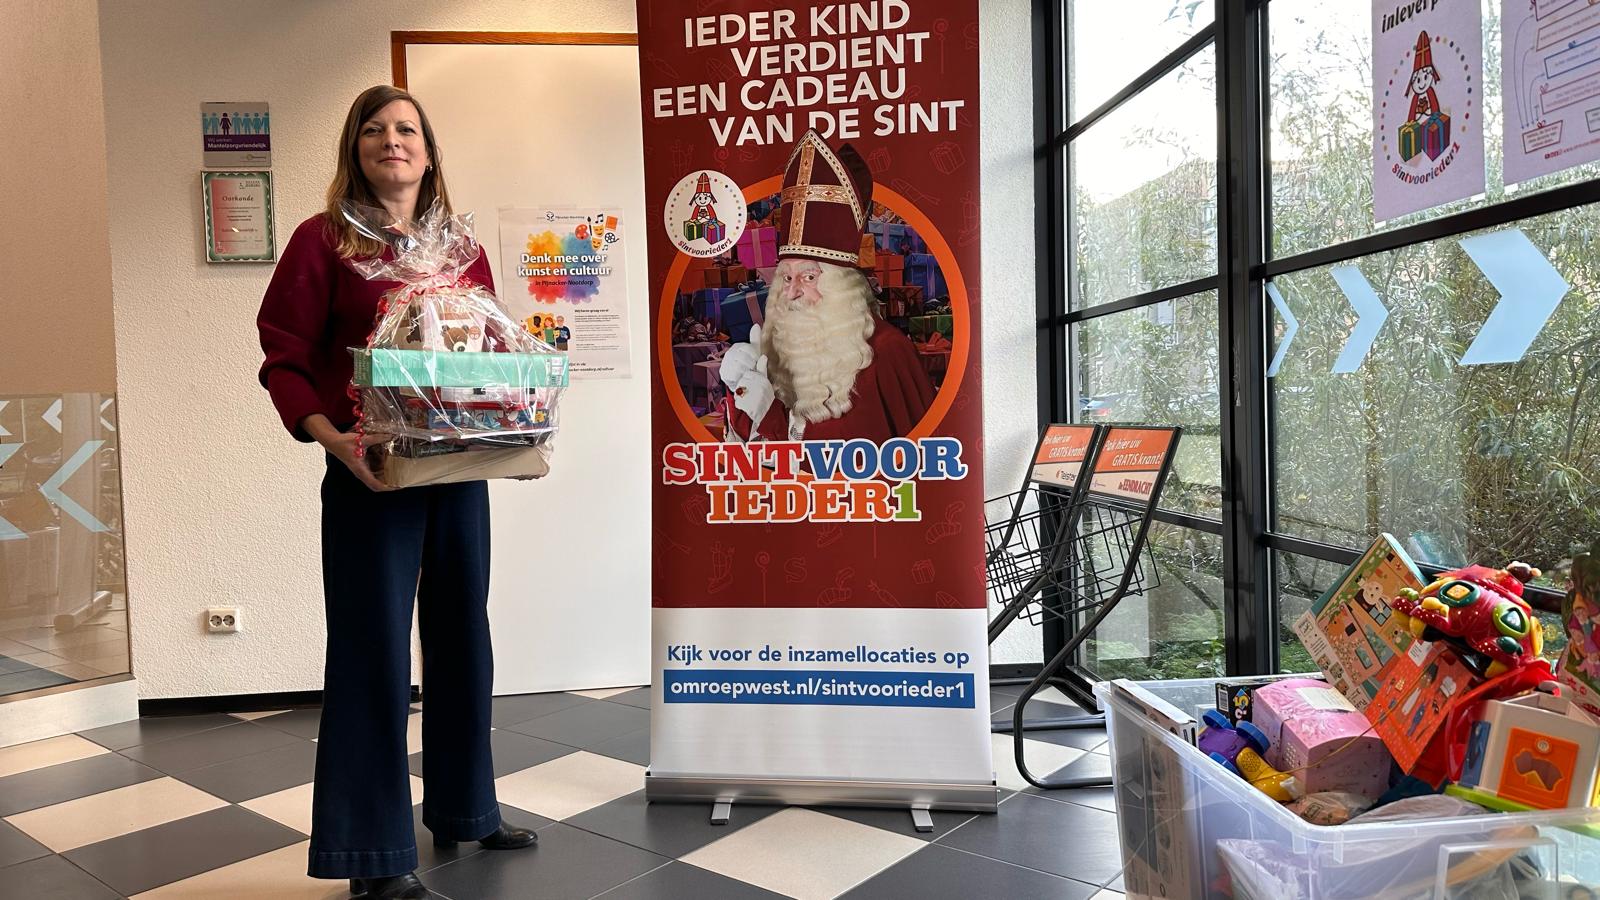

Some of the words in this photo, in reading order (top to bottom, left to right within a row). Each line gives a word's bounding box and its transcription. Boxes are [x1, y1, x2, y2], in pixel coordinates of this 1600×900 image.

[684, 9, 796, 48] IEDER
[810, 0, 910, 37] KIND
[730, 32, 930, 77] VERDIENT
[653, 82, 726, 118] EEN
[740, 67, 906, 111] CADEAU
[708, 113, 793, 147] VAN
[809, 108, 860, 140] DE
[874, 100, 965, 137] SINT
[521, 253, 551, 263] Denk
[554, 255, 578, 263] mee
[581, 254, 606, 263] over
[518, 266, 551, 276] kunst
[553, 268, 567, 276] en
[569, 265, 611, 276] cultuur
[1049, 446, 1067, 458] GRATIS
[1114, 438, 1130, 450] hier
[1130, 439, 1142, 448] uw
[1112, 453, 1139, 467] GRATIS
[1138, 451, 1165, 466] krant!
[706, 481, 921, 523] IEDER1
[667, 645, 702, 666] Kijk
[709, 648, 752, 662] voor
[758, 645, 782, 662] de
[788, 646, 937, 664] inzamellocaties
[943, 650, 969, 669] op
[671, 677, 965, 699] omroepwest.nl/sintvoorieder1
